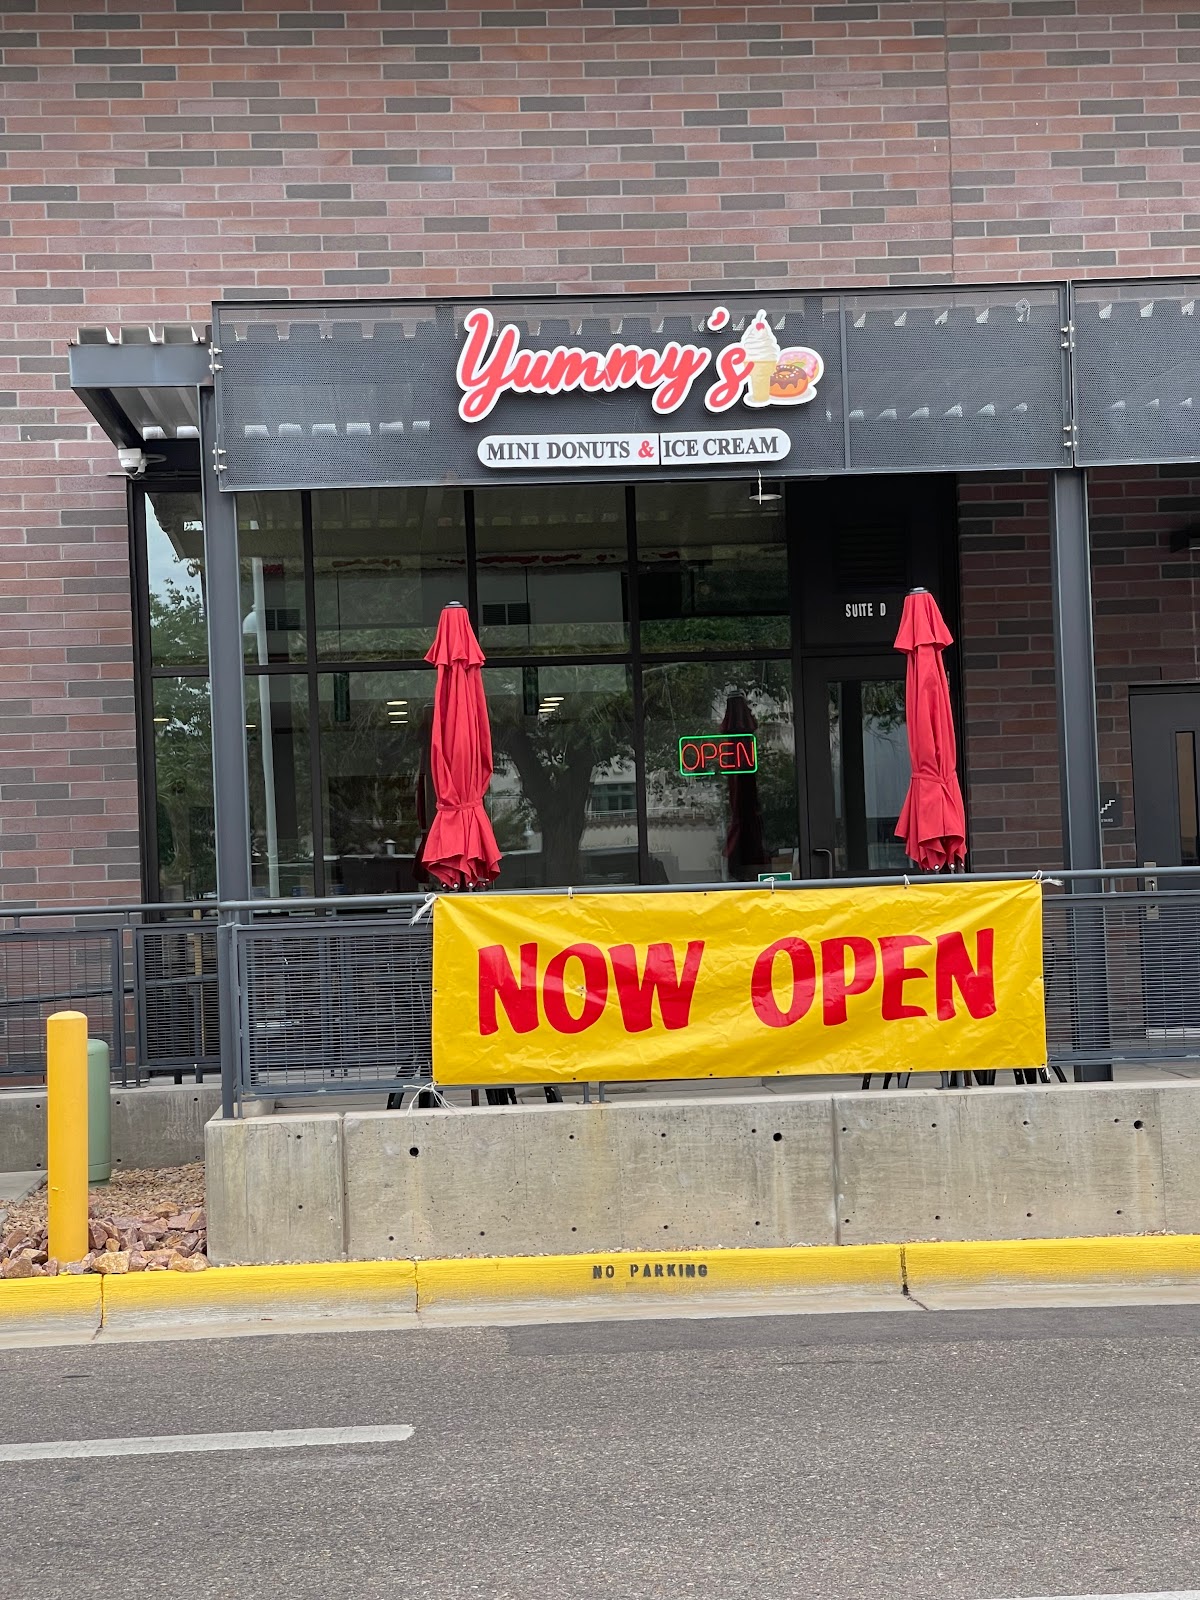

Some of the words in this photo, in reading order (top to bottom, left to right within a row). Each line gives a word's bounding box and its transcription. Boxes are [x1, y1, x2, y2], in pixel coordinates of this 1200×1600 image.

[459, 309, 755, 419] Yummy's
[486, 442, 540, 461] MINI
[546, 440, 630, 460] DONUTS
[637, 440, 655, 459] &
[663, 439, 699, 458] ICE
[702, 436, 779, 456] CREAM
[845, 603, 873, 617] SUITE
[879, 602, 886, 616] D
[681, 741, 755, 771] OPEN
[477, 940, 705, 1036] NOW
[750, 927, 998, 1029] OPEN
[592, 1265, 615, 1279] NO
[630, 1263, 708, 1278] PARKING
